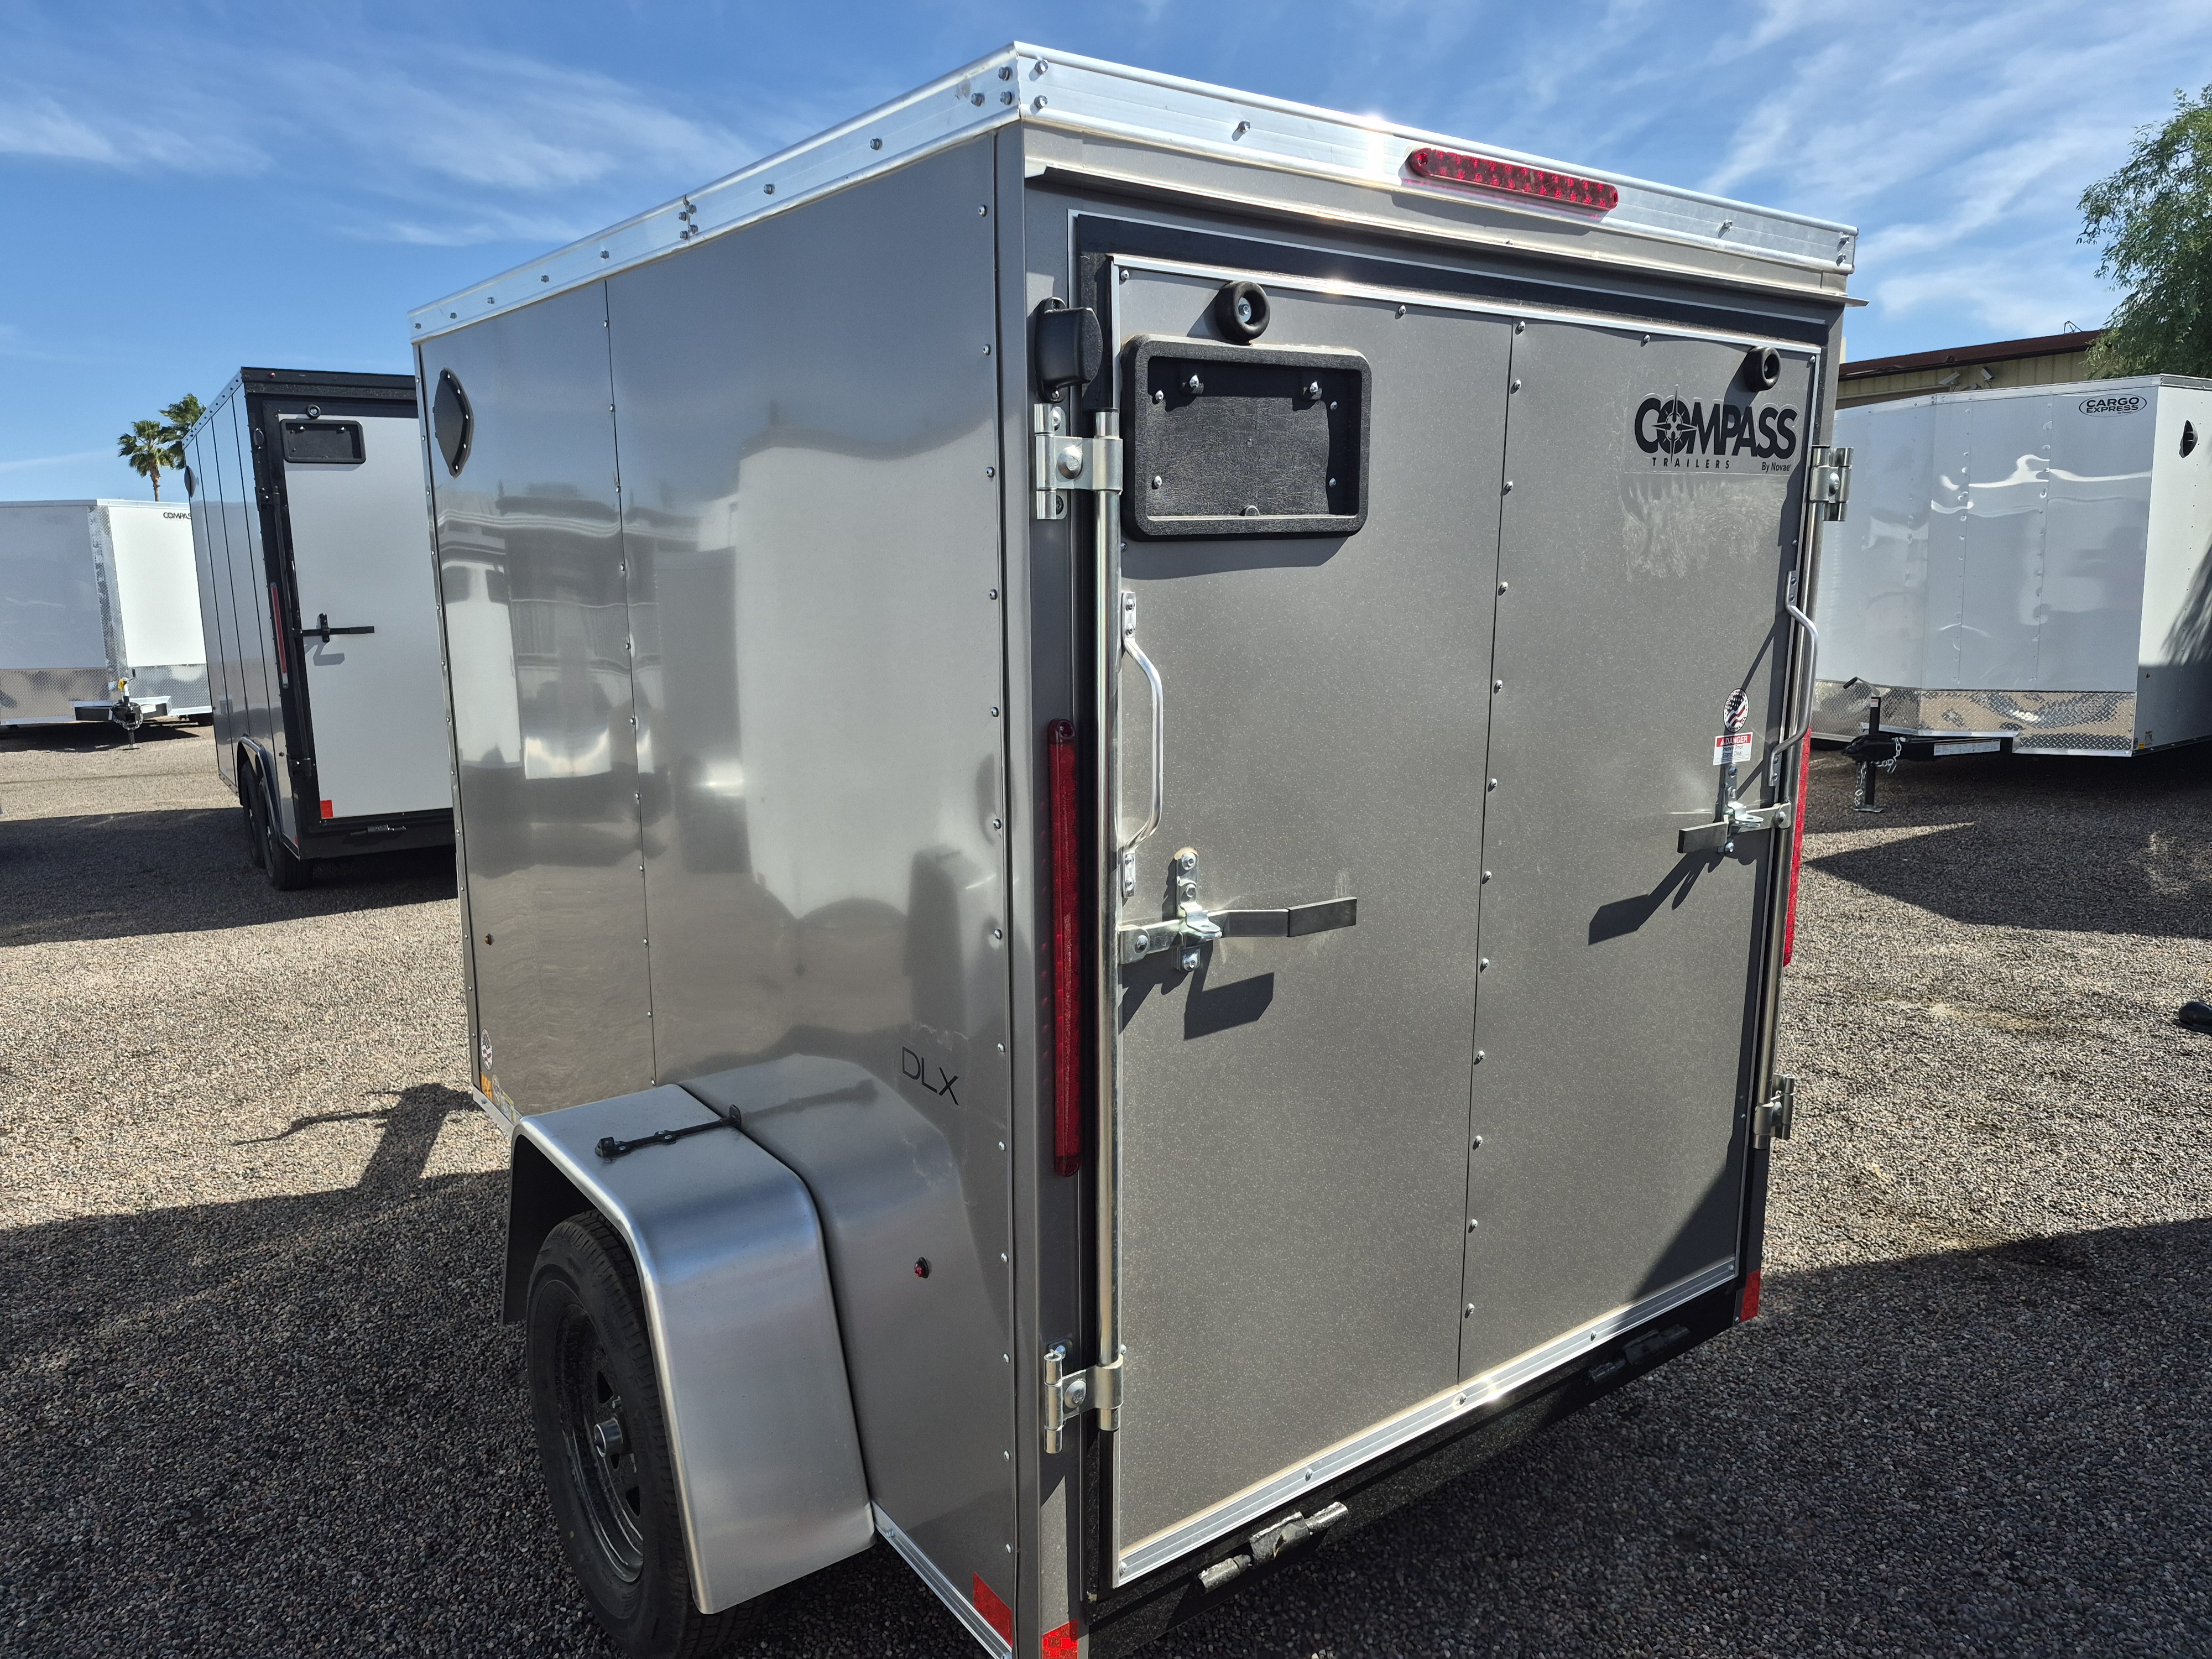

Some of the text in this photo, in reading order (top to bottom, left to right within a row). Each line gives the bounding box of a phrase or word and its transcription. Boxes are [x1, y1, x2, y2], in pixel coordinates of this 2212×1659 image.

[2086, 397, 2139, 407] CARGO
[2086, 405, 2139, 413] EXPRESS
[1634, 397, 1798, 460] COMPASS
[1652, 457, 1730, 469] TRAILERS
[1761, 461, 1770, 473] By
[1725, 735, 1747, 745] DANGER
[901, 1046, 959, 1106] DLX
